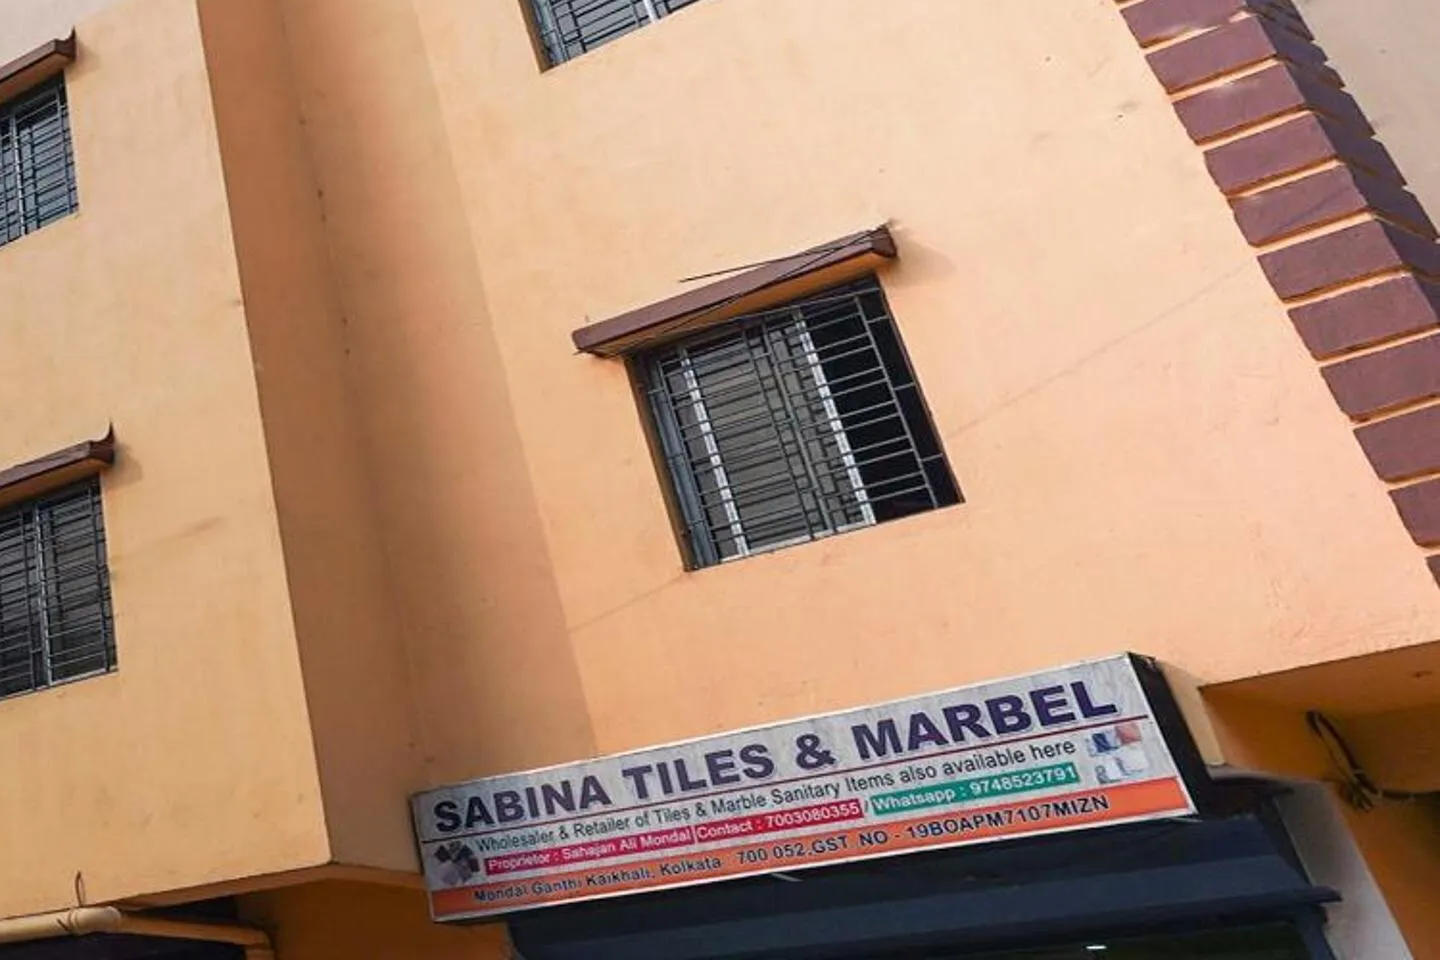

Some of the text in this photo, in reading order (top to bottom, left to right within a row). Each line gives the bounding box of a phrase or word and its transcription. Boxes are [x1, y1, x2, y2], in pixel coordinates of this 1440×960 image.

[434, 680, 1117, 834] SABINA TILES & MARBEL
[476, 740, 1077, 852] Wholesaler & Retailer of Tiles & Marble Sanitary Items also available here
[640, 829, 691, 848] Mondal
[697, 820, 753, 840] Contact
[873, 788, 955, 811] Whatsapp
[969, 766, 1078, 795] 9748523791
[660, 856, 722, 876] Kolkata
[736, 847, 768, 864] 700
[859, 830, 888, 847] NO
